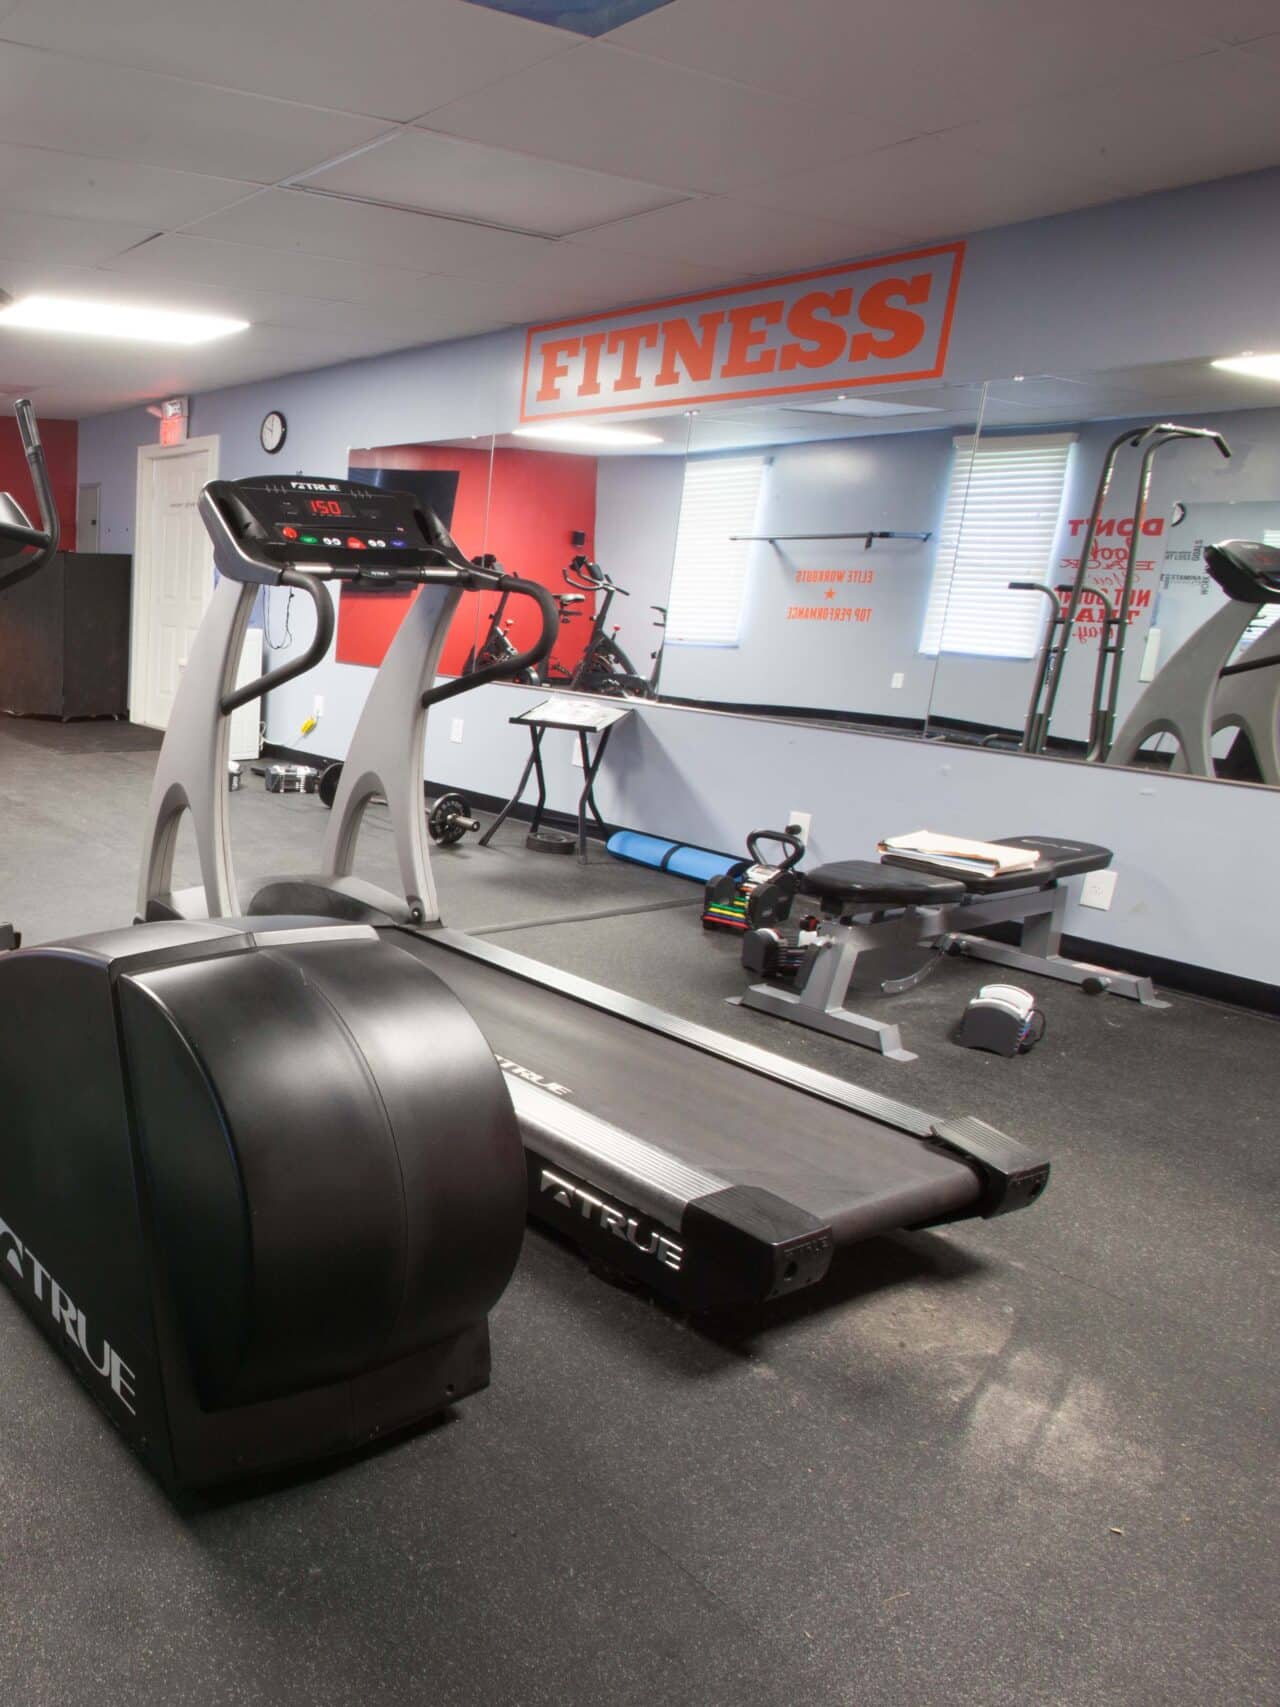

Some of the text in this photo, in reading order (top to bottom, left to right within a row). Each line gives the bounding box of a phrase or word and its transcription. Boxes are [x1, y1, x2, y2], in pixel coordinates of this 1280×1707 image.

[536, 273, 933, 402] FITNESS
[311, 500, 342, 515] 150
[511, 1066, 574, 1095] TRUE
[574, 1188, 683, 1270] TRUE
[24, 1247, 136, 1417] TRUE
